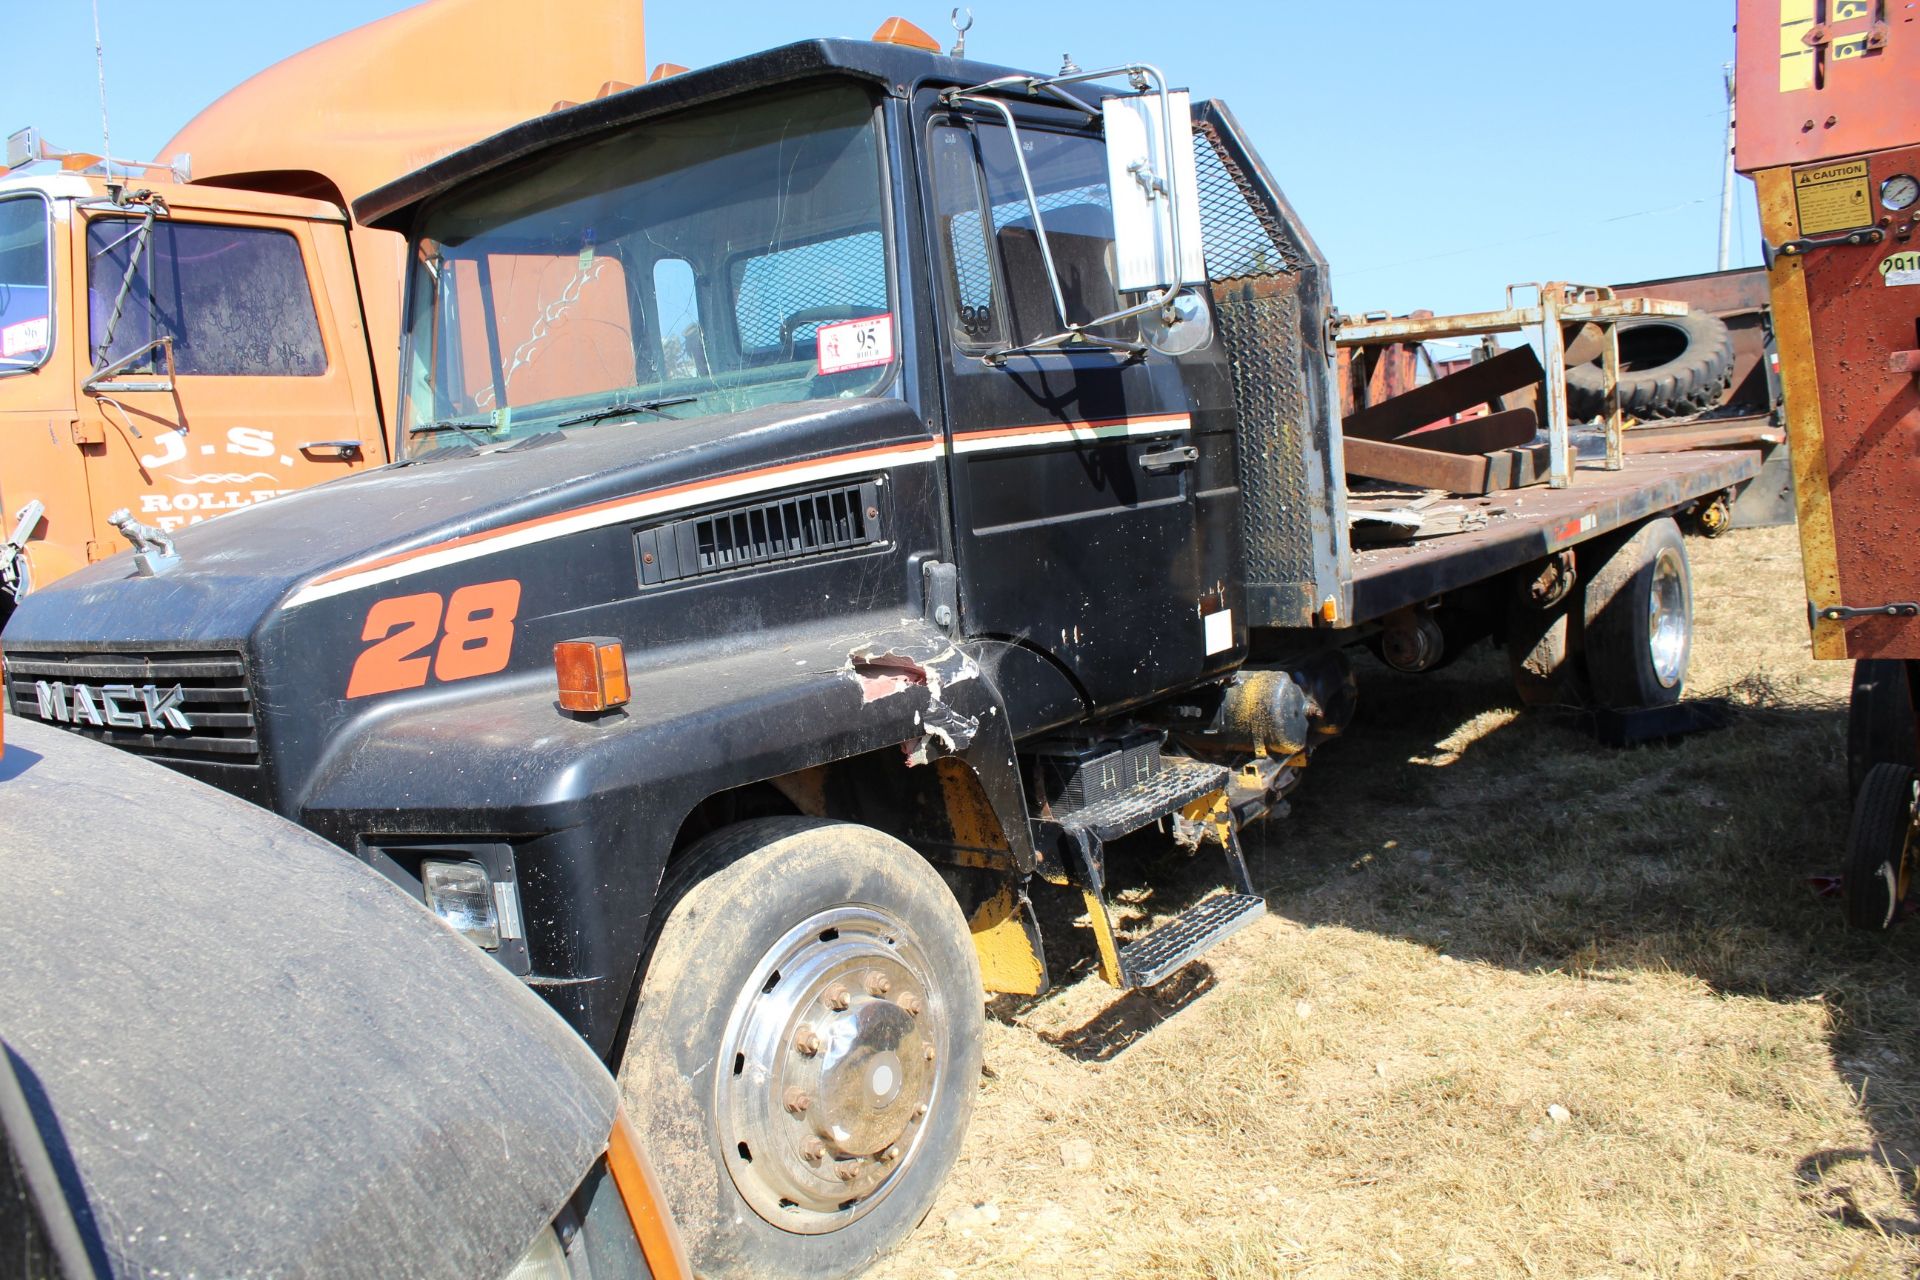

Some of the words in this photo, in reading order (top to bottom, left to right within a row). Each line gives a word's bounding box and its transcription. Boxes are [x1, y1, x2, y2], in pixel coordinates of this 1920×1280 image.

[1812, 164, 1863, 181] CAUTION
[856, 327, 877, 351] 95
[346, 578, 522, 701] 28
[34, 680, 193, 732] MACK
